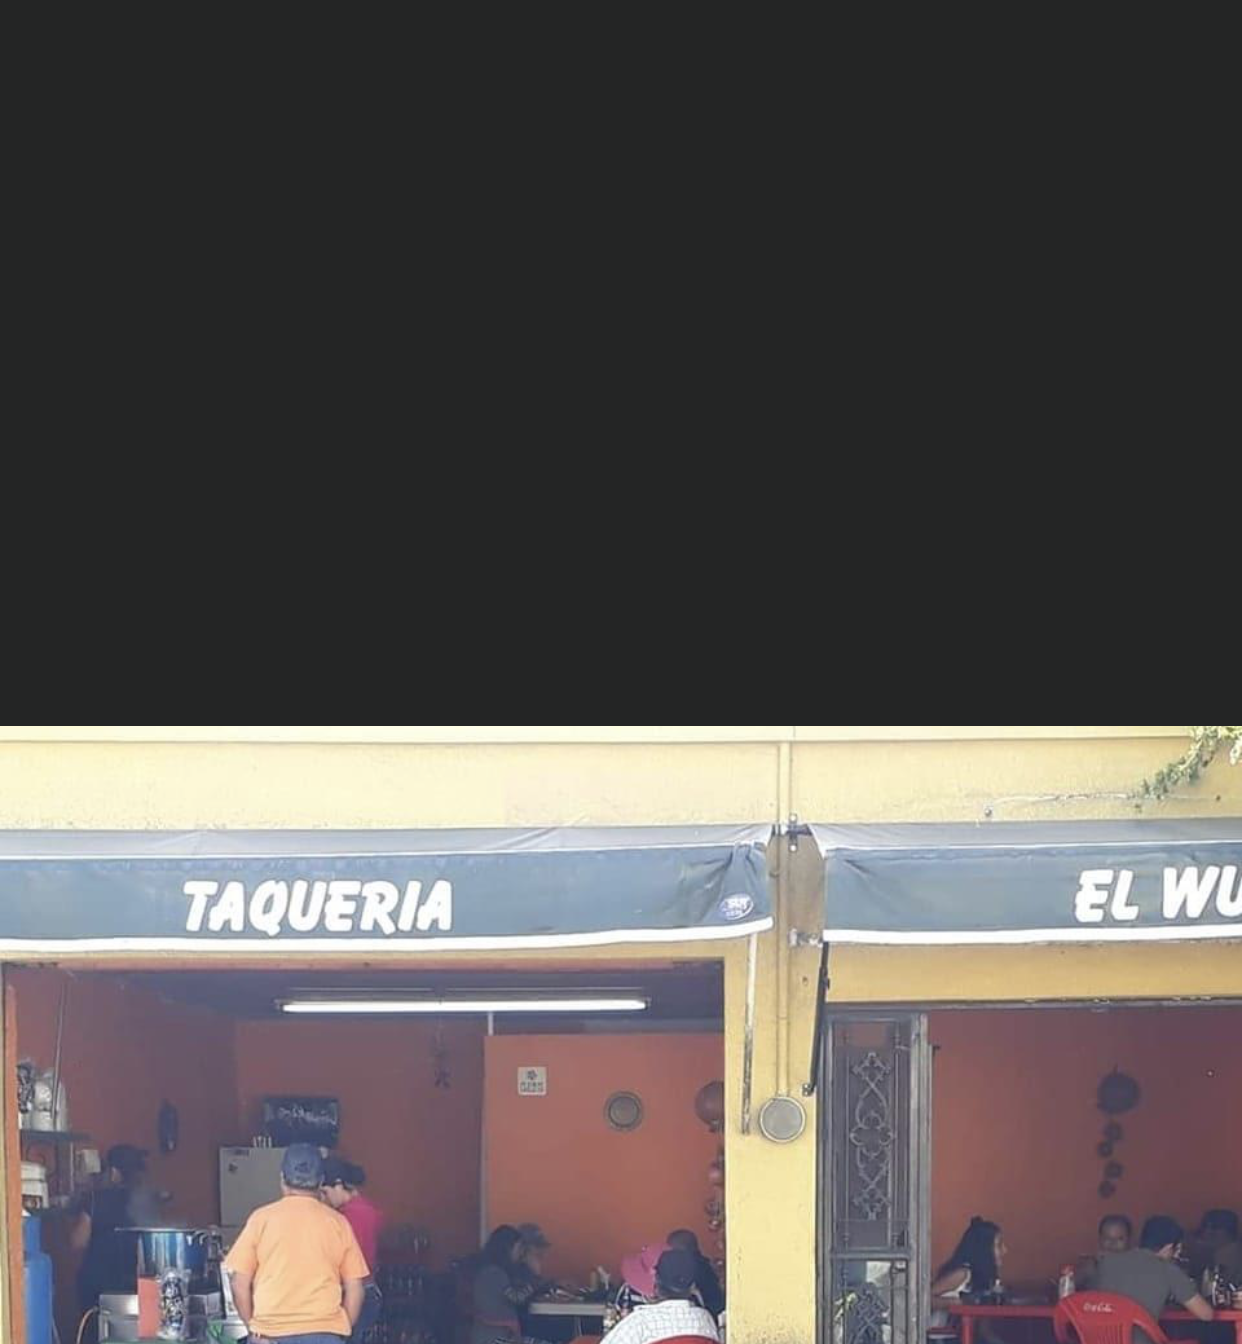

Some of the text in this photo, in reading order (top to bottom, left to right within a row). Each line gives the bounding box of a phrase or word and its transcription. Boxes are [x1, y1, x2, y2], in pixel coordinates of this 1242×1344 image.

[183, 879, 453, 937] TAQUERIA
[1074, 864, 1242, 923] EL WU
